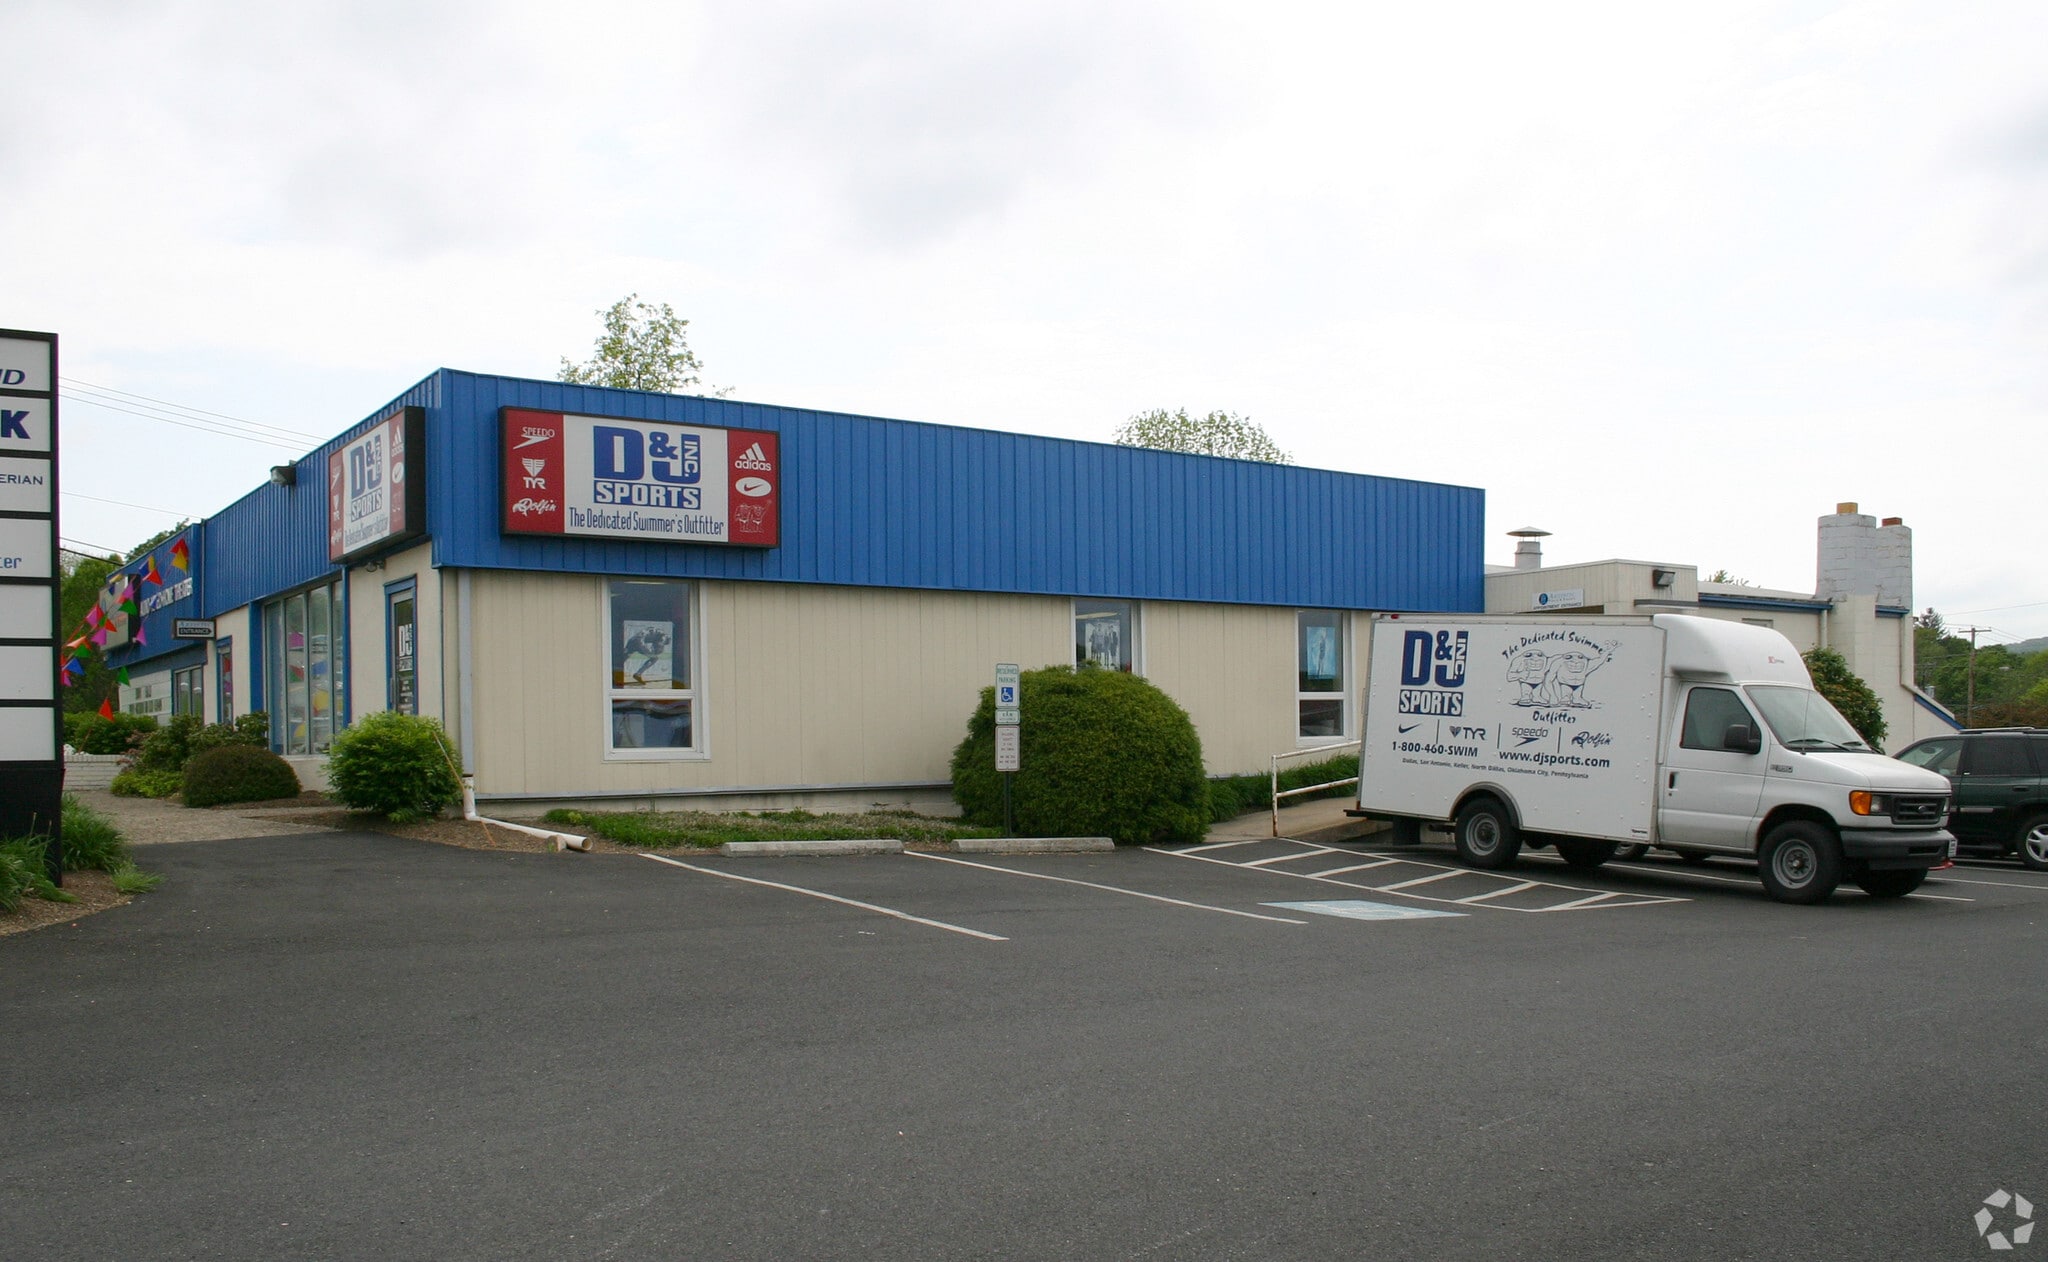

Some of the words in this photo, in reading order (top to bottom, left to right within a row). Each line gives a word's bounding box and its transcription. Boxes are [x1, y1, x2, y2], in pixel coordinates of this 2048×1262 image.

[0, 369, 26, 385] D
[522, 426, 555, 438] SPEEDO
[593, 425, 701, 485] D&J
[684, 440, 698, 478] INC.
[735, 458, 772, 471] adidas
[523, 476, 546, 490] TYR
[350, 488, 383, 522] SPORTS
[595, 481, 700, 509] SPORTS
[569, 507, 585, 527] The
[587, 508, 632, 530] Dedicated
[633, 511, 682, 534] Swimmer's
[684, 514, 724, 535] Outfitter
[1502, 644, 1520, 660] The
[1520, 630, 1567, 648] Dedicated
[1401, 630, 1469, 688] D&J
[1454, 638, 1467, 681] INC.
[1399, 690, 1463, 716] SPORTS
[1532, 710, 1577, 725] Outfitter
[1463, 727, 1486, 740] TYR
[1512, 727, 1549, 738] speedo
[1392, 741, 1478, 757] 1-800-460-SWIM
[1499, 751, 1610, 768] www.djsports.com
